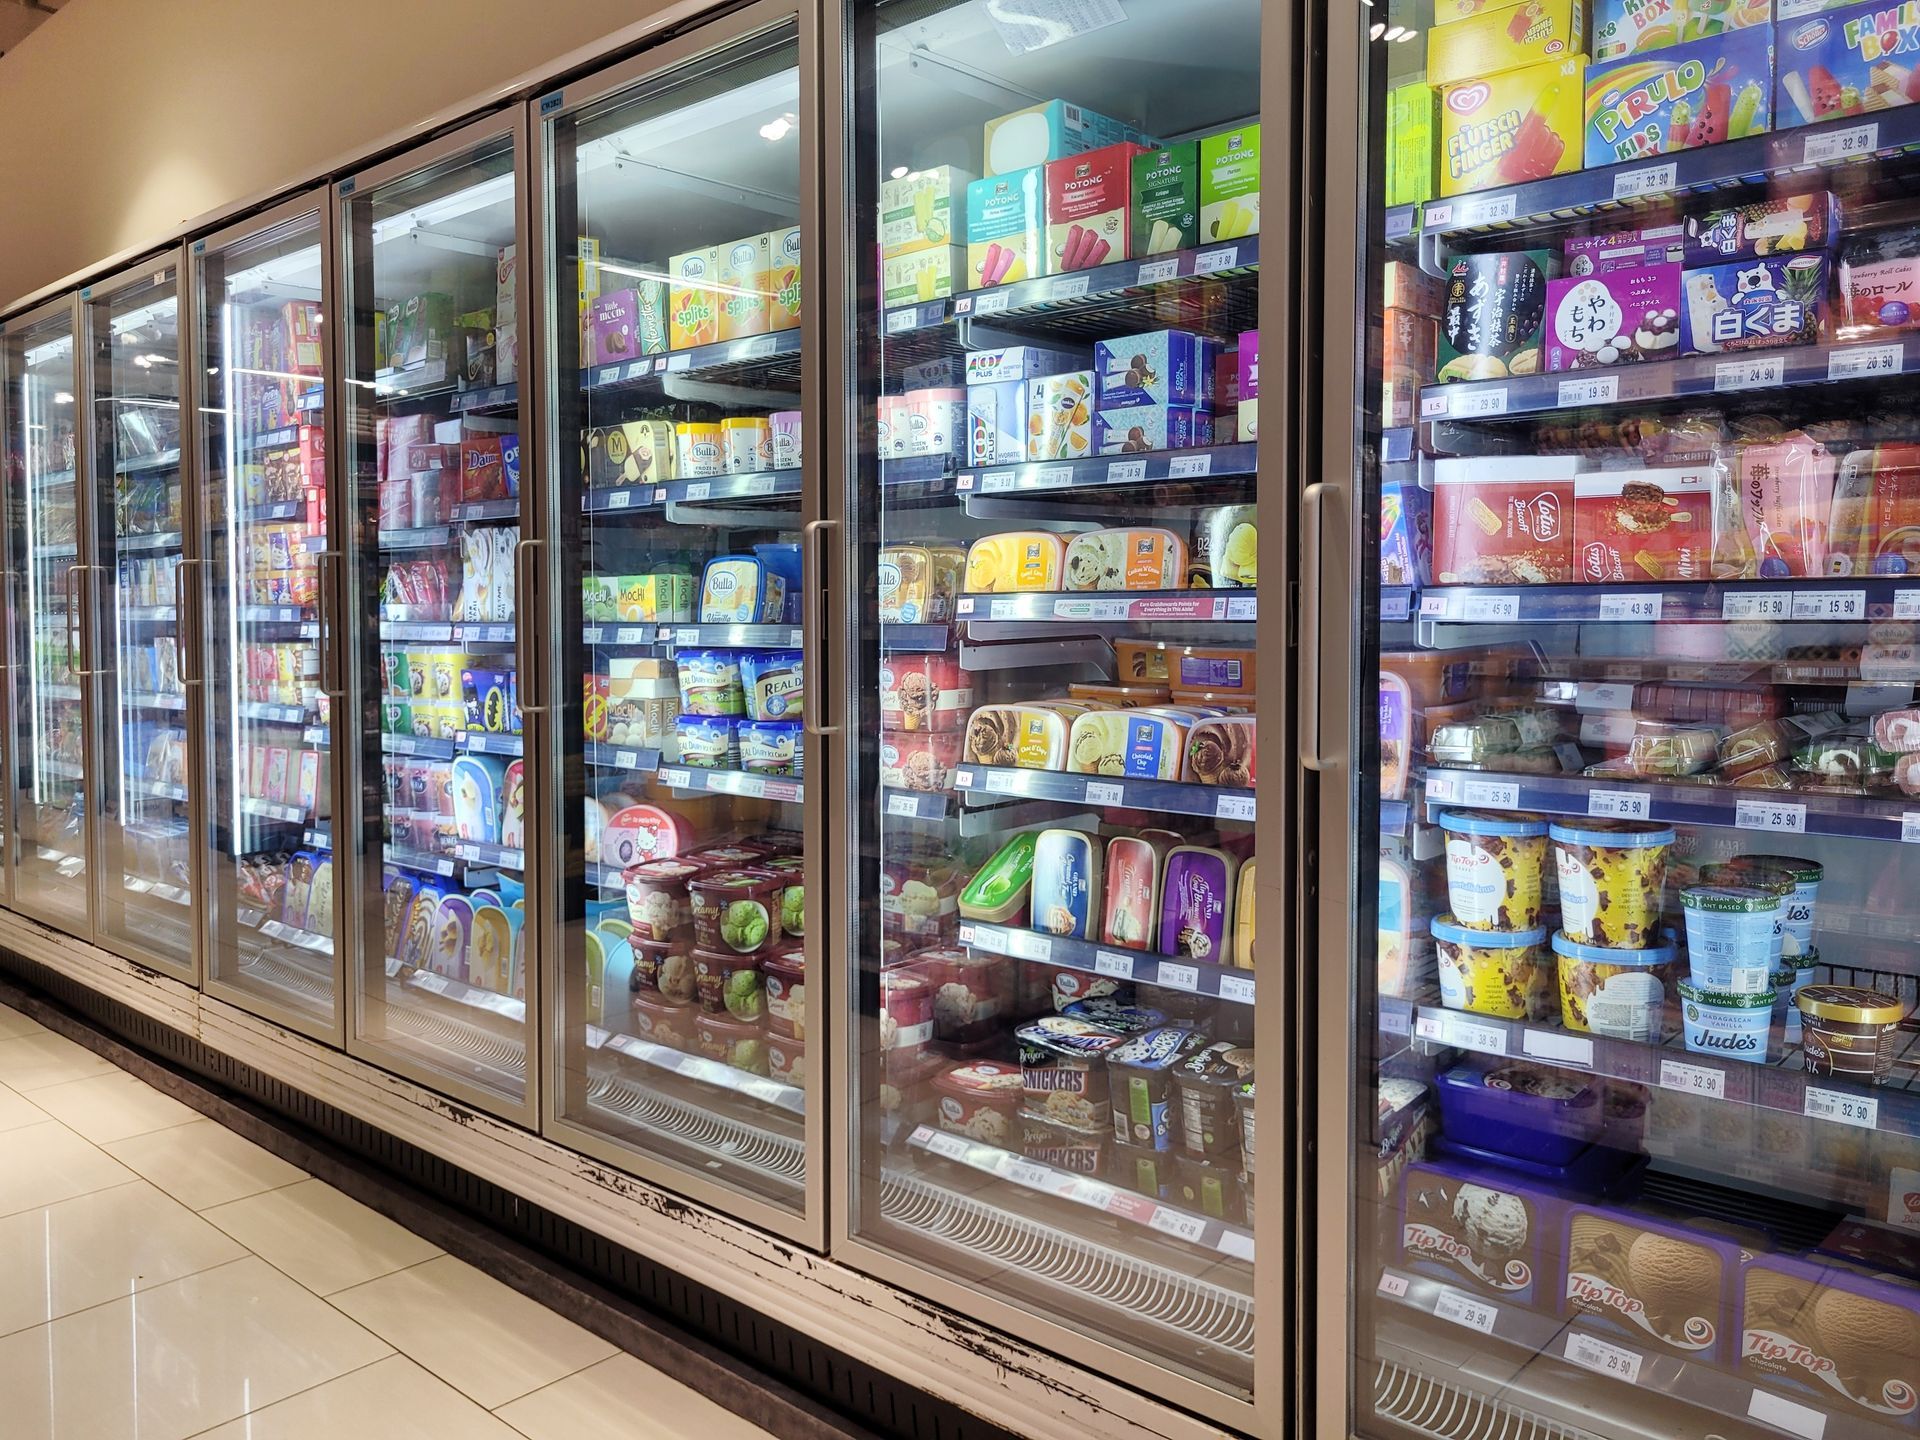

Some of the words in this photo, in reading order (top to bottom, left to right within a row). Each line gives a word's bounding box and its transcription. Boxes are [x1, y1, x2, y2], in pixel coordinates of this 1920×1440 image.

[1844, 1, 1920, 49] FAMIL
[1448, 110, 1523, 156] FLUTSCH
[1614, 123, 1662, 160] KIDS
[1842, 135, 1868, 150] 32.90
[1216, 149, 1254, 165] POTONG
[1450, 131, 1516, 179] FINGER
[1146, 165, 1182, 180] POTONG
[1646, 173, 1668, 187] 32.90
[1064, 175, 1103, 191] POTONG
[1147, 176, 1179, 188] SIGNATURE
[985, 193, 1019, 207] POTONG
[1490, 204, 1508, 217] 32.90
[786, 236, 800, 252] Bul
[684, 264, 703, 276] Bulla
[779, 283, 800, 305] spli
[678, 304, 709, 325] splits
[1714, 303, 1801, 341] 白くま
[1866, 355, 1893, 370] 20.90
[976, 370, 993, 378] PLUS
[1750, 367, 1775, 381] 24.90
[1588, 385, 1610, 398] 19.90
[1480, 398, 1500, 411] 29.90
[468, 450, 496, 469] Daim
[695, 447, 716, 457] Bulla
[1514, 498, 1529, 535] Biscoff
[1538, 500, 1557, 536] Lotus
[1587, 547, 1603, 578] Lotus
[1679, 548, 1694, 578] Mini
[712, 577, 733, 590] Bulla
[1492, 604, 1512, 615] 45.90
[1631, 603, 1653, 614] 43.90
[1758, 600, 1783, 613] 15.90
[1829, 600, 1854, 613] 15.90
[764, 680, 792, 697] REAL
[1491, 791, 1511, 803] 25.90
[1619, 801, 1642, 813] 25.90
[1771, 813, 1797, 826] 25.90
[1701, 1013, 1752, 1022] MADAGASCAN
[1711, 1021, 1743, 1029] VANILLA
[1694, 1029, 1758, 1050] Jude's
[1019, 1048, 1045, 1065] Breyers
[1805, 1045, 1825, 1059] ude's
[1023, 1069, 1083, 1092] SNICKERS
[1693, 1075, 1716, 1090] 32.90
[1842, 1103, 1867, 1120] 32.90
[1571, 1297, 1602, 1313] Chocolate
[1465, 1308, 1487, 1326] 29.90
[1607, 1355, 1631, 1374] 29.90
[1749, 1355, 1787, 1373] Chocolate
